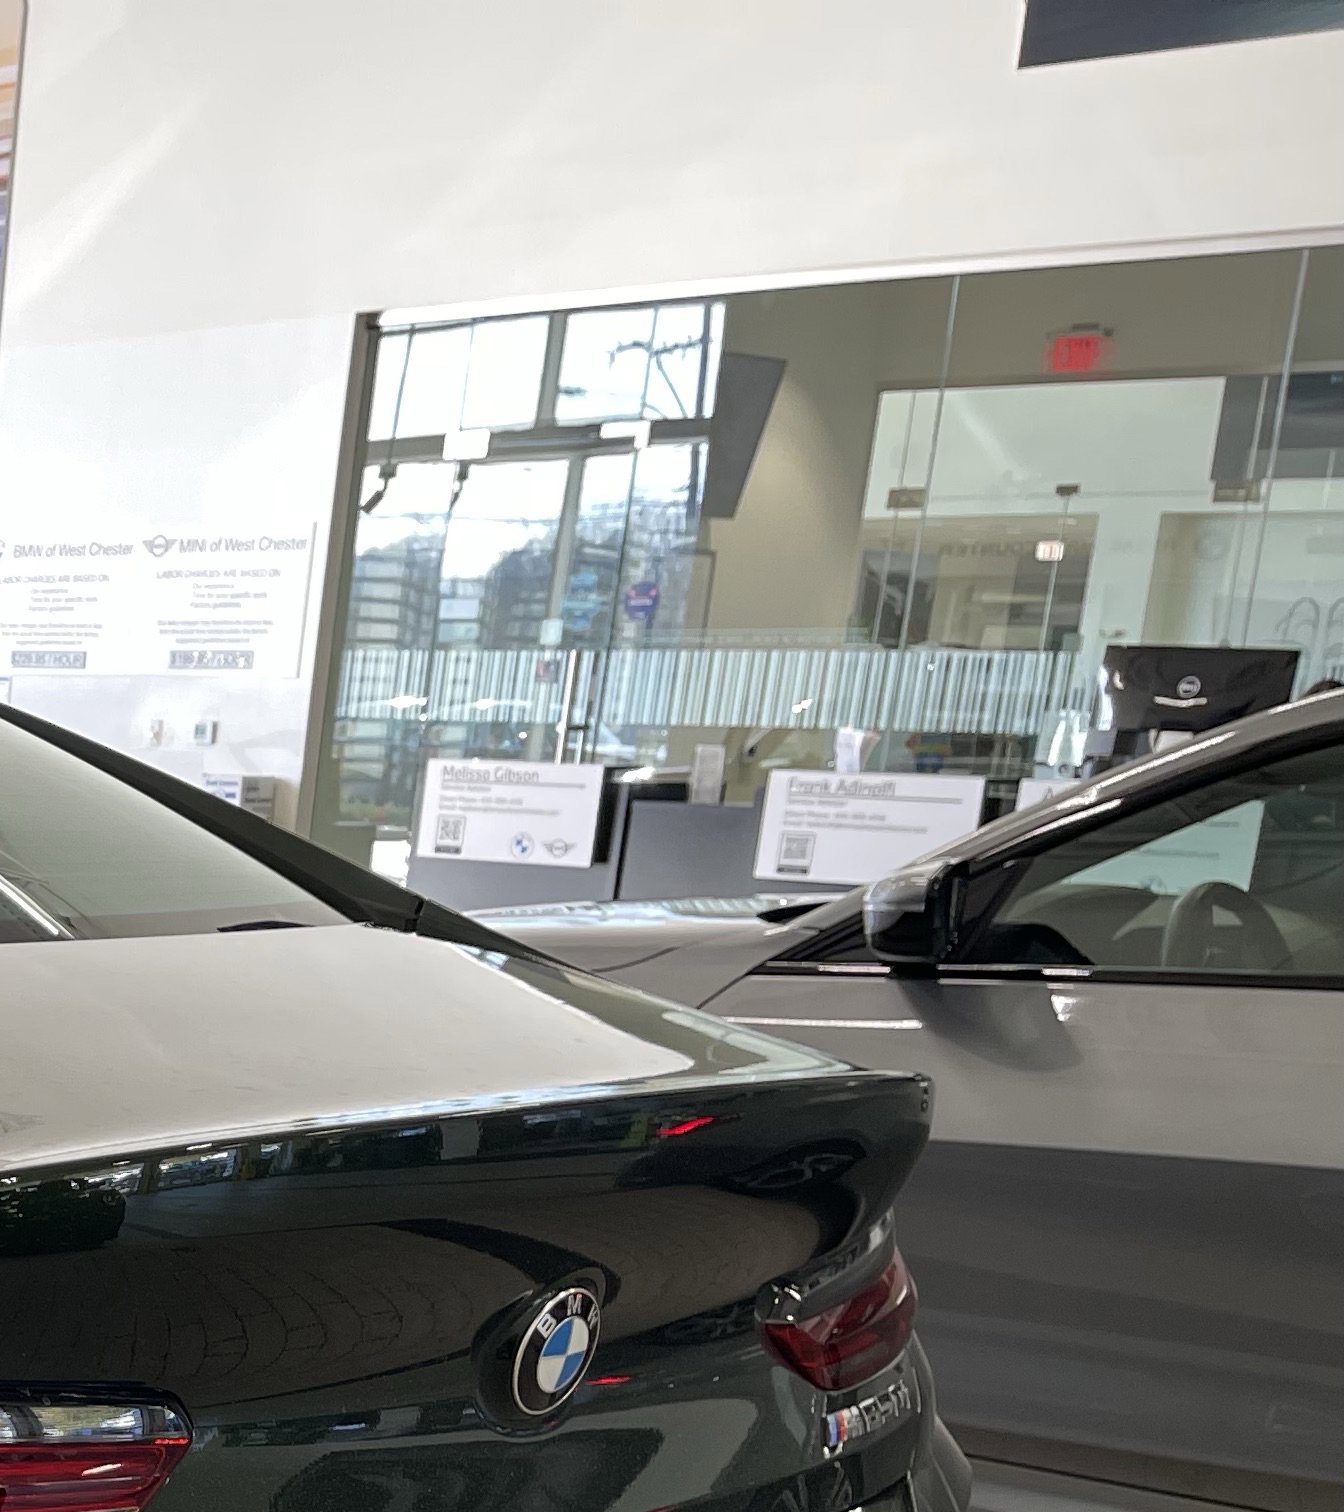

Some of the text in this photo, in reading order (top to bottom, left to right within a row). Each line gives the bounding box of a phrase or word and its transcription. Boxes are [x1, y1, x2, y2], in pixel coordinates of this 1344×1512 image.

[13, 544, 43, 559] BMW
[45, 544, 57, 557] of
[58, 543, 86, 557] West
[88, 541, 134, 556] Chester
[179, 535, 308, 553] MINI of West Chester
